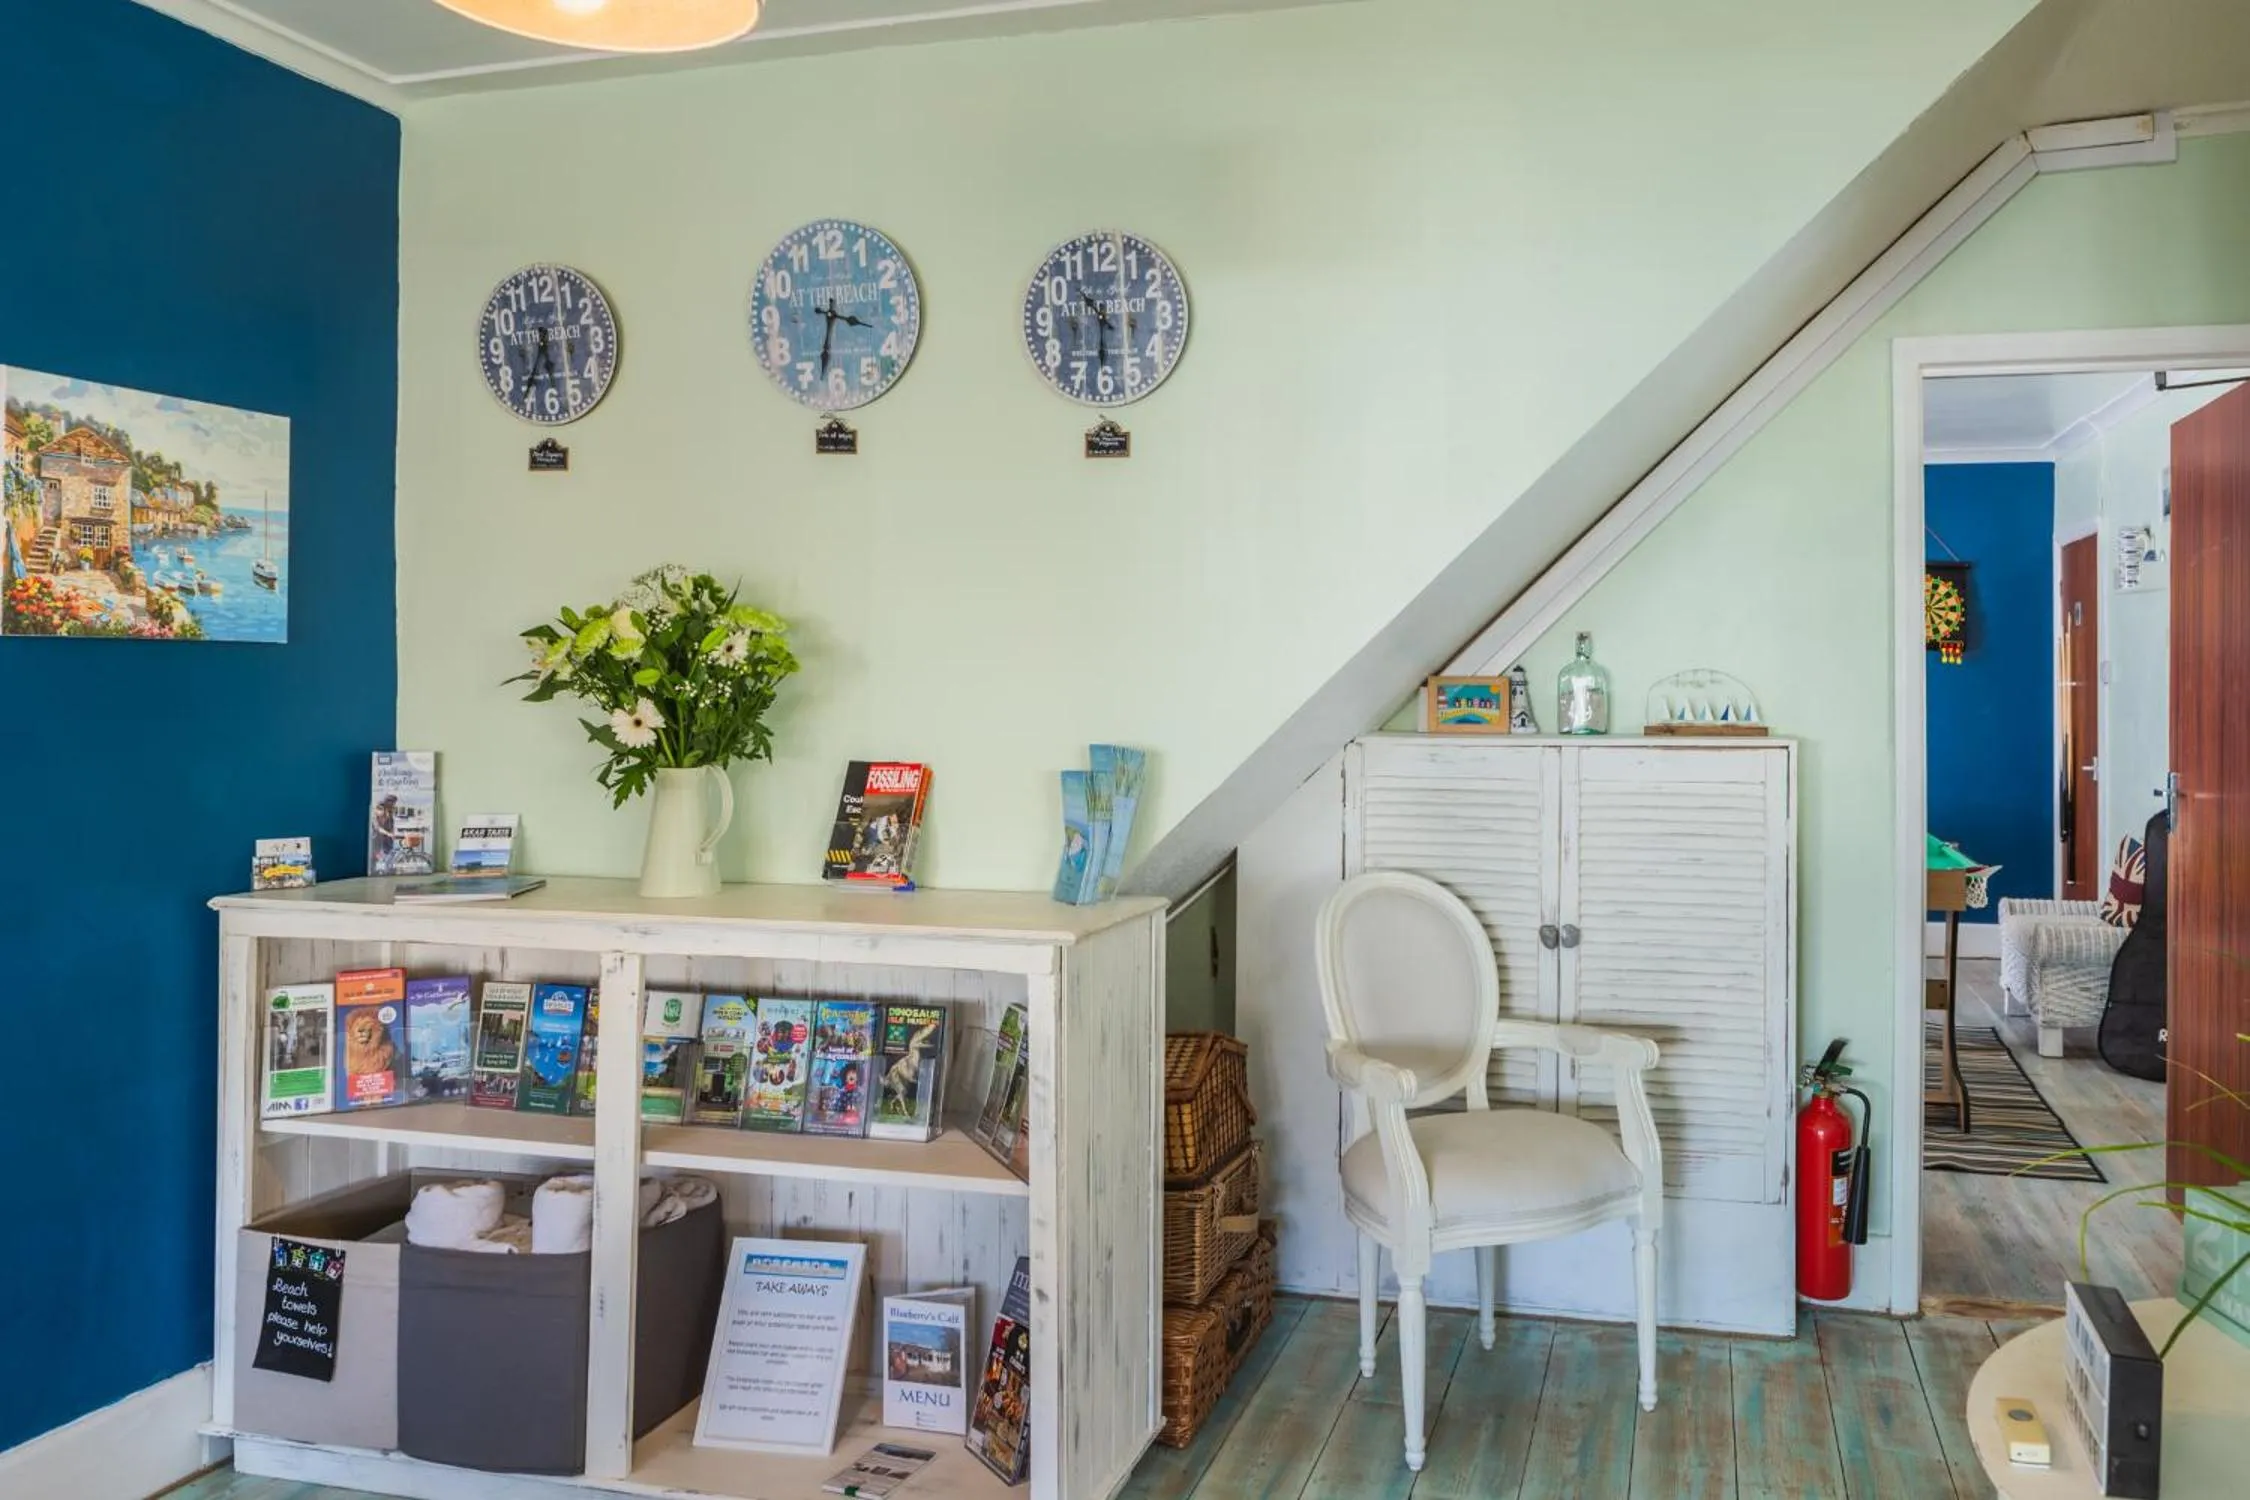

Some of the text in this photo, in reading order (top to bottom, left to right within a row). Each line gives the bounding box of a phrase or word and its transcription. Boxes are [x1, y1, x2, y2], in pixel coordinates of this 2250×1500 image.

[788, 243, 809, 273] 11
[812, 229, 844, 260] 12
[852, 238, 866, 267] 1
[1087, 242, 1117, 272] 12
[877, 260, 897, 289] 2
[1061, 250, 1083, 281] 11
[1126, 250, 1138, 280] 1
[528, 276, 554, 303] 12
[561, 282, 572, 308] 1
[764, 270, 791, 299] 10
[790, 282, 877, 308] AT THE BEACH
[1039, 276, 1067, 305] 10
[1145, 268, 1162, 298] 2
[507, 285, 526, 312] 11
[578, 298, 594, 325] 2
[890, 296, 908, 324] 3
[1061, 302, 1076, 316] AT
[1107, 298, 1145, 313] BEACH
[491, 308, 515, 337] 10
[762, 306, 780, 333] 9
[1036, 307, 1050, 336] 9
[1157, 301, 1172, 330] 3
[511, 324, 580, 345] AT TH BEACH
[590, 326, 604, 353] 3
[880, 332, 900, 361] 4
[1145, 333, 1161, 363] 4
[489, 338, 504, 364] 9
[768, 338, 790, 366] 8
[1045, 339, 1061, 368] 8
[500, 366, 513, 392] 8
[584, 356, 597, 384] 4
[796, 361, 813, 389] 7
[828, 368, 847, 397] 6
[860, 356, 880, 386] 5
[1070, 361, 1087, 389] 7
[1098, 365, 1113, 395] 6
[1126, 358, 1141, 386] 5
[545, 388, 559, 414] 6
[568, 379, 582, 405] 5
[866, 770, 920, 789] FOSSILING
[888, 1008, 940, 1018] DINOSAUR
[272, 1277, 308, 1297] Beach
[756, 1282, 829, 1296] TAKE AWAYS
[282, 1297, 317, 1315] towels
[267, 1311, 328, 1337] please help
[274, 1330, 332, 1358] yourselves!
[899, 1388, 950, 1407] MENU
